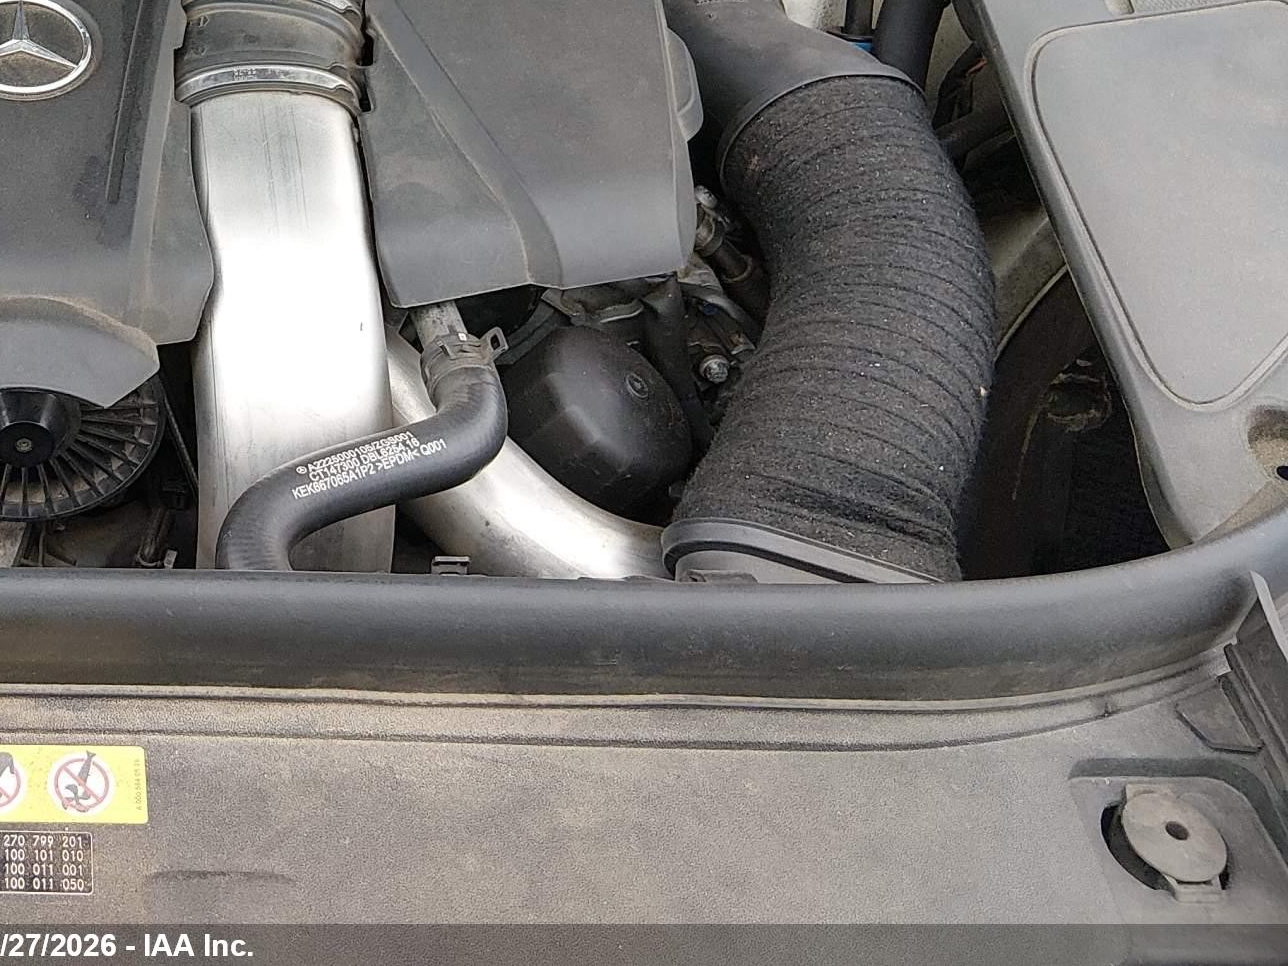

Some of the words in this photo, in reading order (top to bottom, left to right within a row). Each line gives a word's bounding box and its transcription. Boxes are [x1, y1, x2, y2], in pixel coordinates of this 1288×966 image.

[376, 449, 420, 470] >EPDM<
[419, 438, 447, 456] Q001
[308, 457, 361, 482] CT147300
[3, 835, 25, 847] 270
[32, 835, 53, 847] 799
[62, 836, 83, 848] 201
[5, 849, 25, 860] 100
[34, 850, 53, 861] 101
[62, 850, 84, 862] 010
[5, 863, 25, 874] 100
[32, 863, 54, 874] 011
[62, 864, 83, 876] 001
[5, 877, 25, 889] 100
[32, 878, 54, 890] 011
[62, 879, 84, 890] 050
